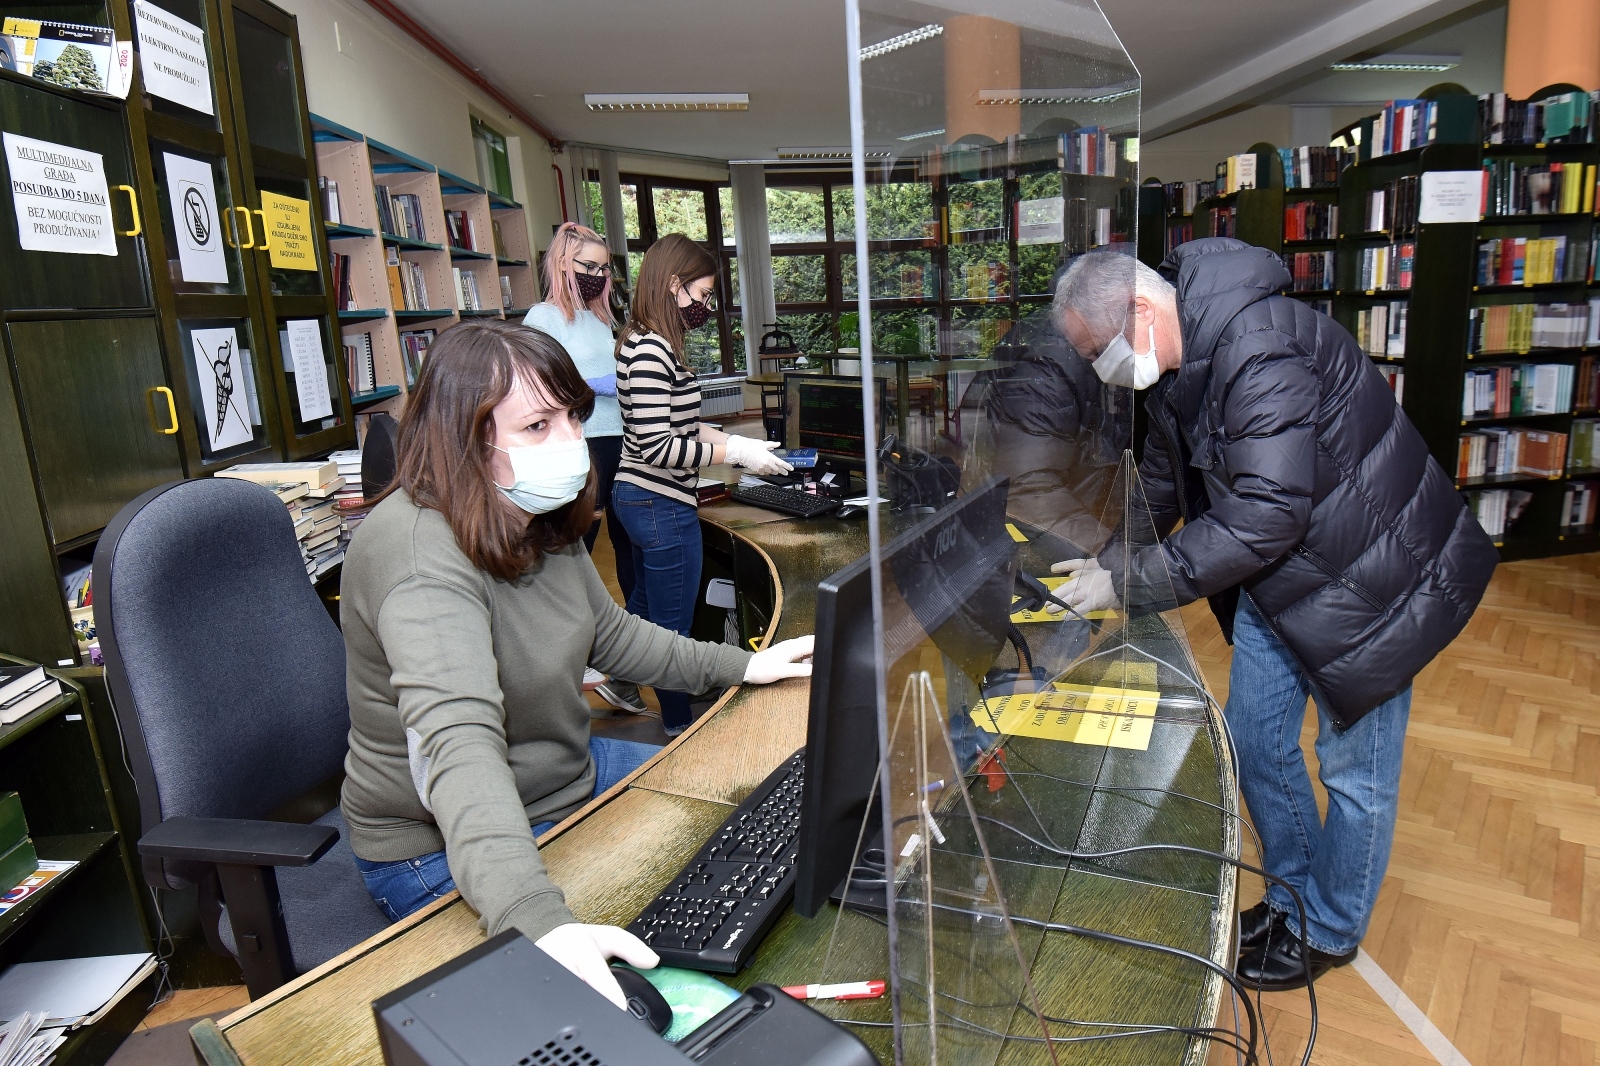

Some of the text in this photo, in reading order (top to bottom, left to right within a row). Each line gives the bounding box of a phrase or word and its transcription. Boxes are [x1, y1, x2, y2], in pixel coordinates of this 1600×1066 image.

[9, 24, 18, 34] 4
[137, 8, 201, 46] REZERVIRANE KNJIGE
[120, 49, 129, 67] 2020
[153, 61, 163, 72] NE
[174, 48, 200, 66] NASLOVI
[199, 59, 207, 68] SE
[16, 145, 94, 172] MULTIMEDIJALNA
[13, 180, 106, 206] POSUDBA DO 5 DANA
[272, 201, 279, 209] ZA
[27, 206, 102, 226] BEZ MOGUĆNOSTI
[33, 222, 97, 239] PRODUŽIVANJA
[933, 522, 957, 560] AOC
[1017, 699, 1031, 712] KOD
